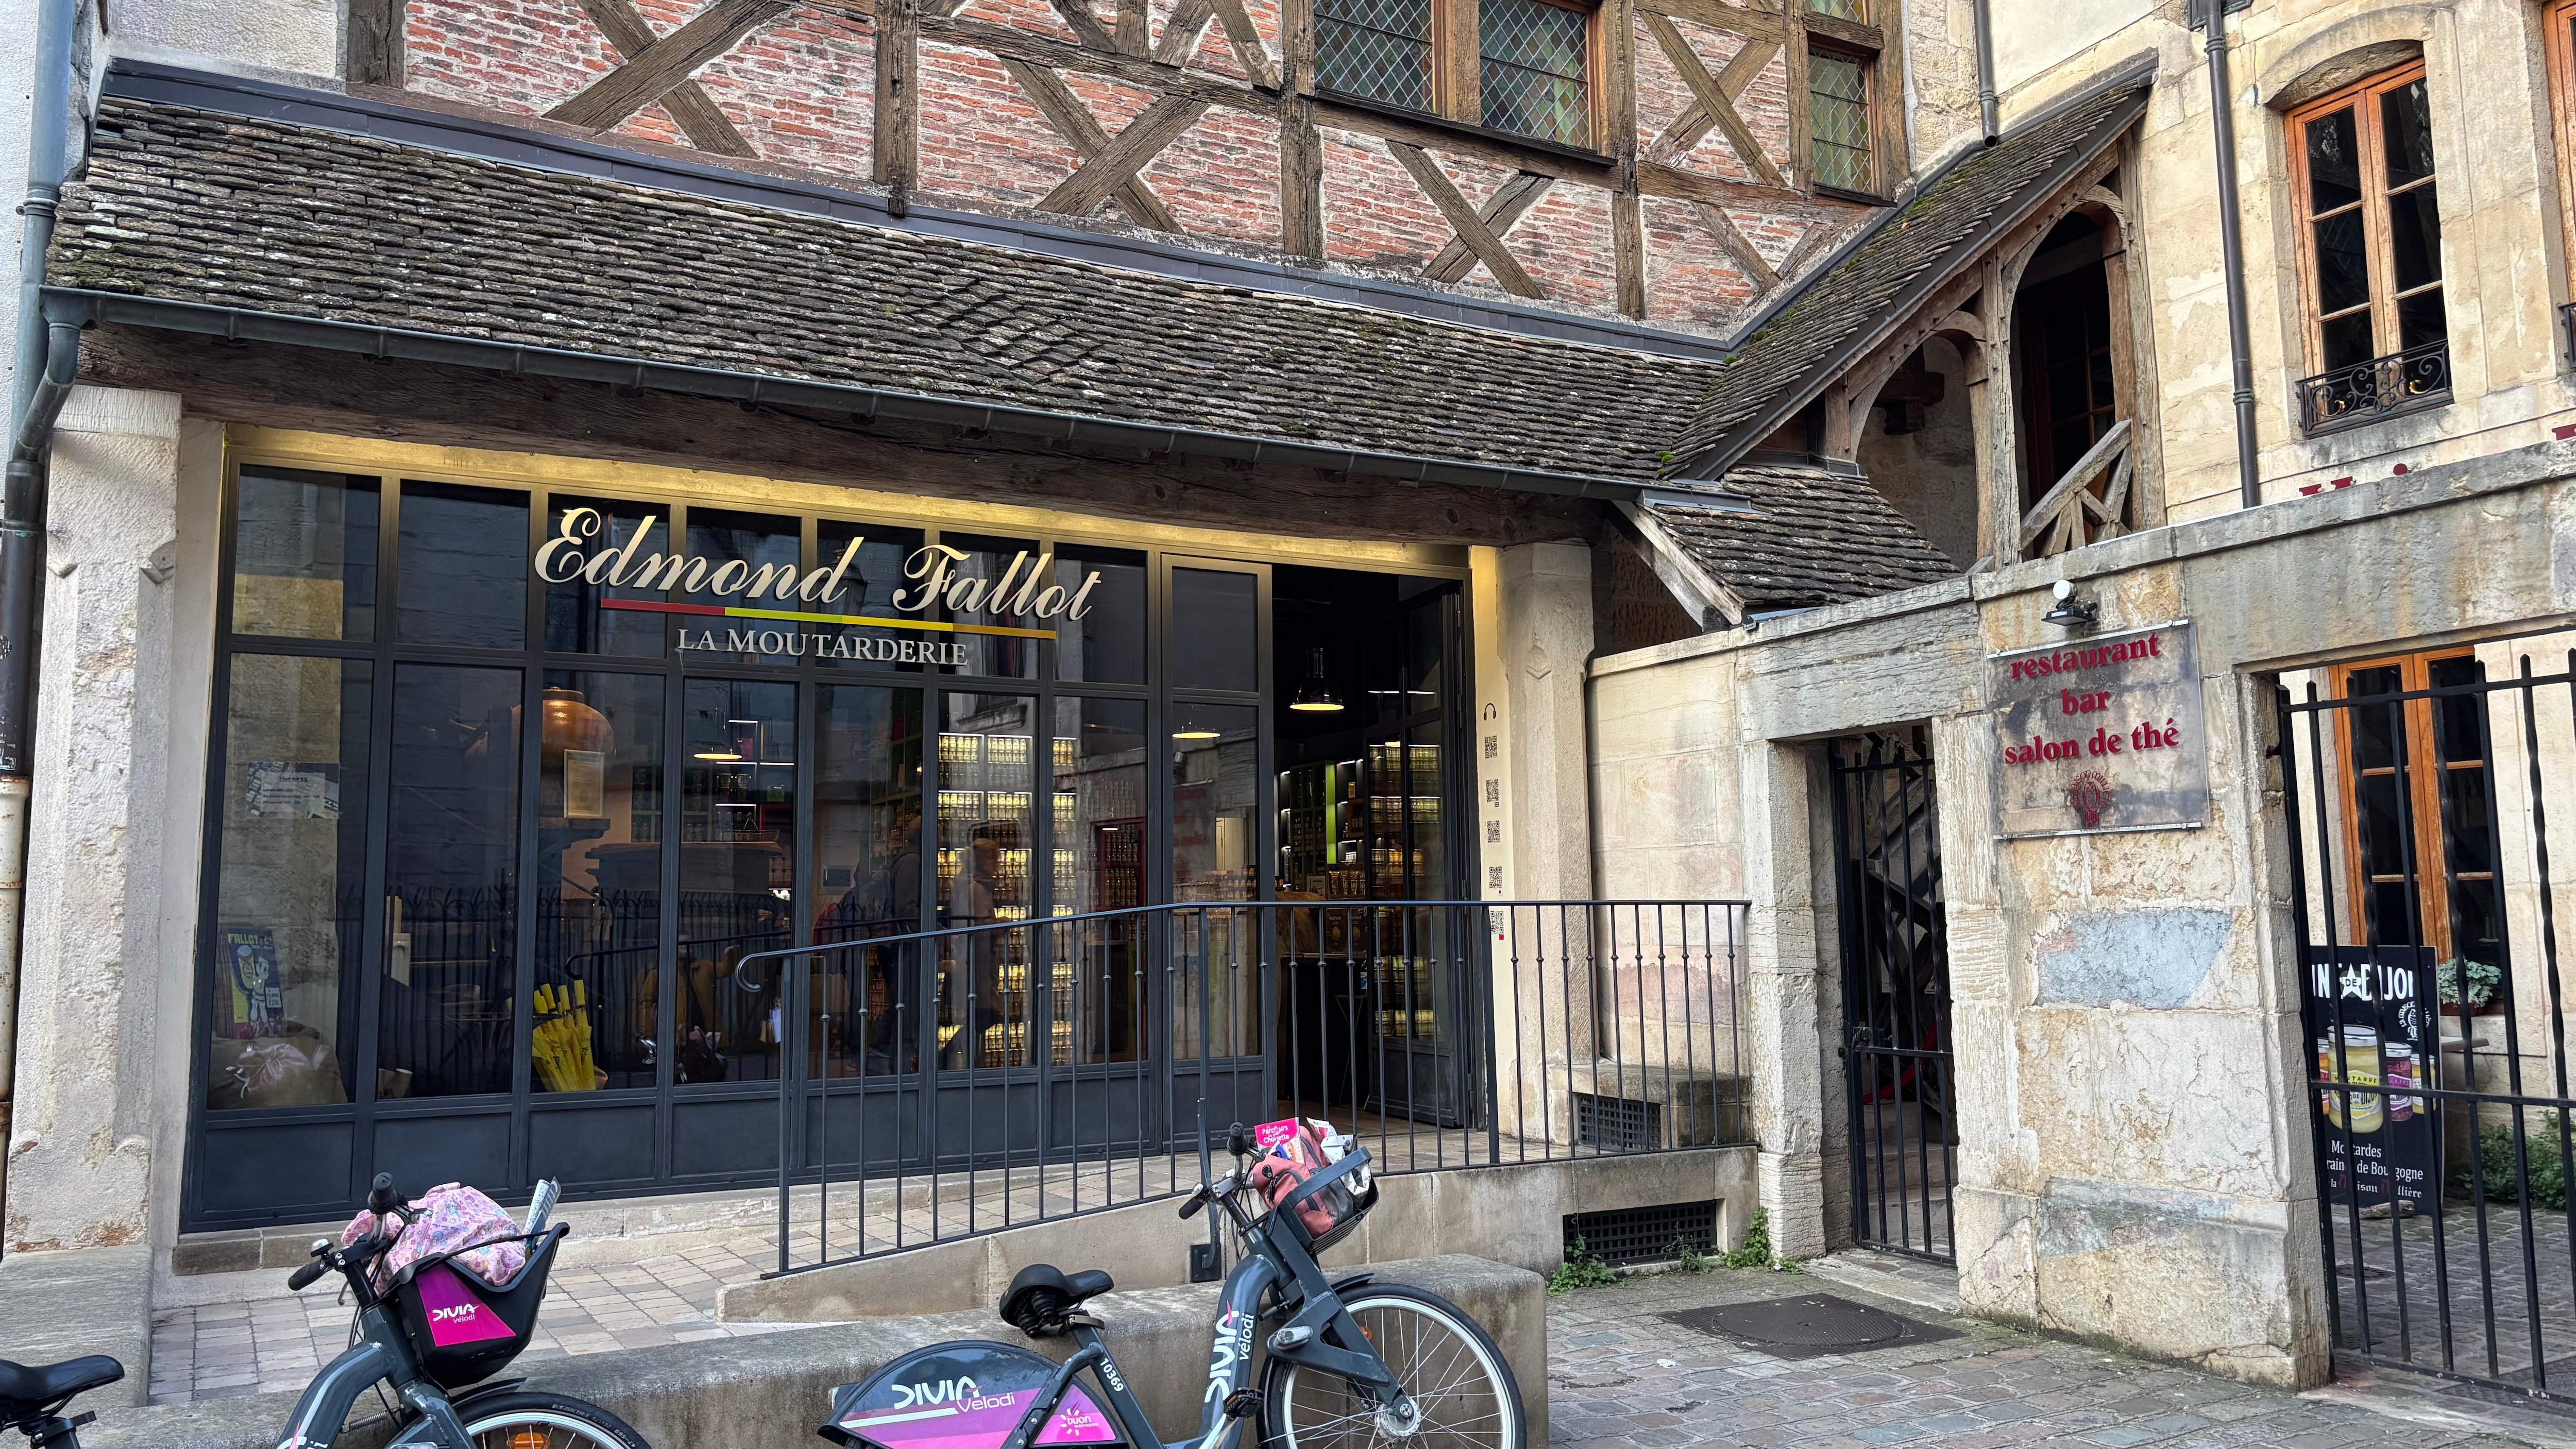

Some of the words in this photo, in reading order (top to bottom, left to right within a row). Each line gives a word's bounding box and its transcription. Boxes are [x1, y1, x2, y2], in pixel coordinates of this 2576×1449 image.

[534, 507, 865, 604] Edmond
[892, 543, 1101, 621] Fallot
[677, 628, 718, 651] LA
[727, 628, 969, 666] MOUTARDERIE
[2011, 632, 2162, 680] restaurant
[2061, 688, 2111, 715] bar
[2005, 736, 2079, 765] salon
[2088, 727, 2122, 756] de
[2130, 718, 2179, 751] thé
[2345, 978, 2358, 987] DE
[2332, 1140, 2382, 1158] Motardes
[2327, 1158, 2346, 1171] rain
[2357, 1160, 2369, 1174] de
[2371, 1162, 2424, 1182] Bougogne
[2331, 1178, 2337, 1188] la
[432, 1303, 477, 1322] DIVIA
[453, 1314, 476, 1323] vélodi
[1238, 1312, 1255, 1360] vélodi
[1100, 1358, 1124, 1392] 10369
[891, 1375, 981, 1410] DIVIA
